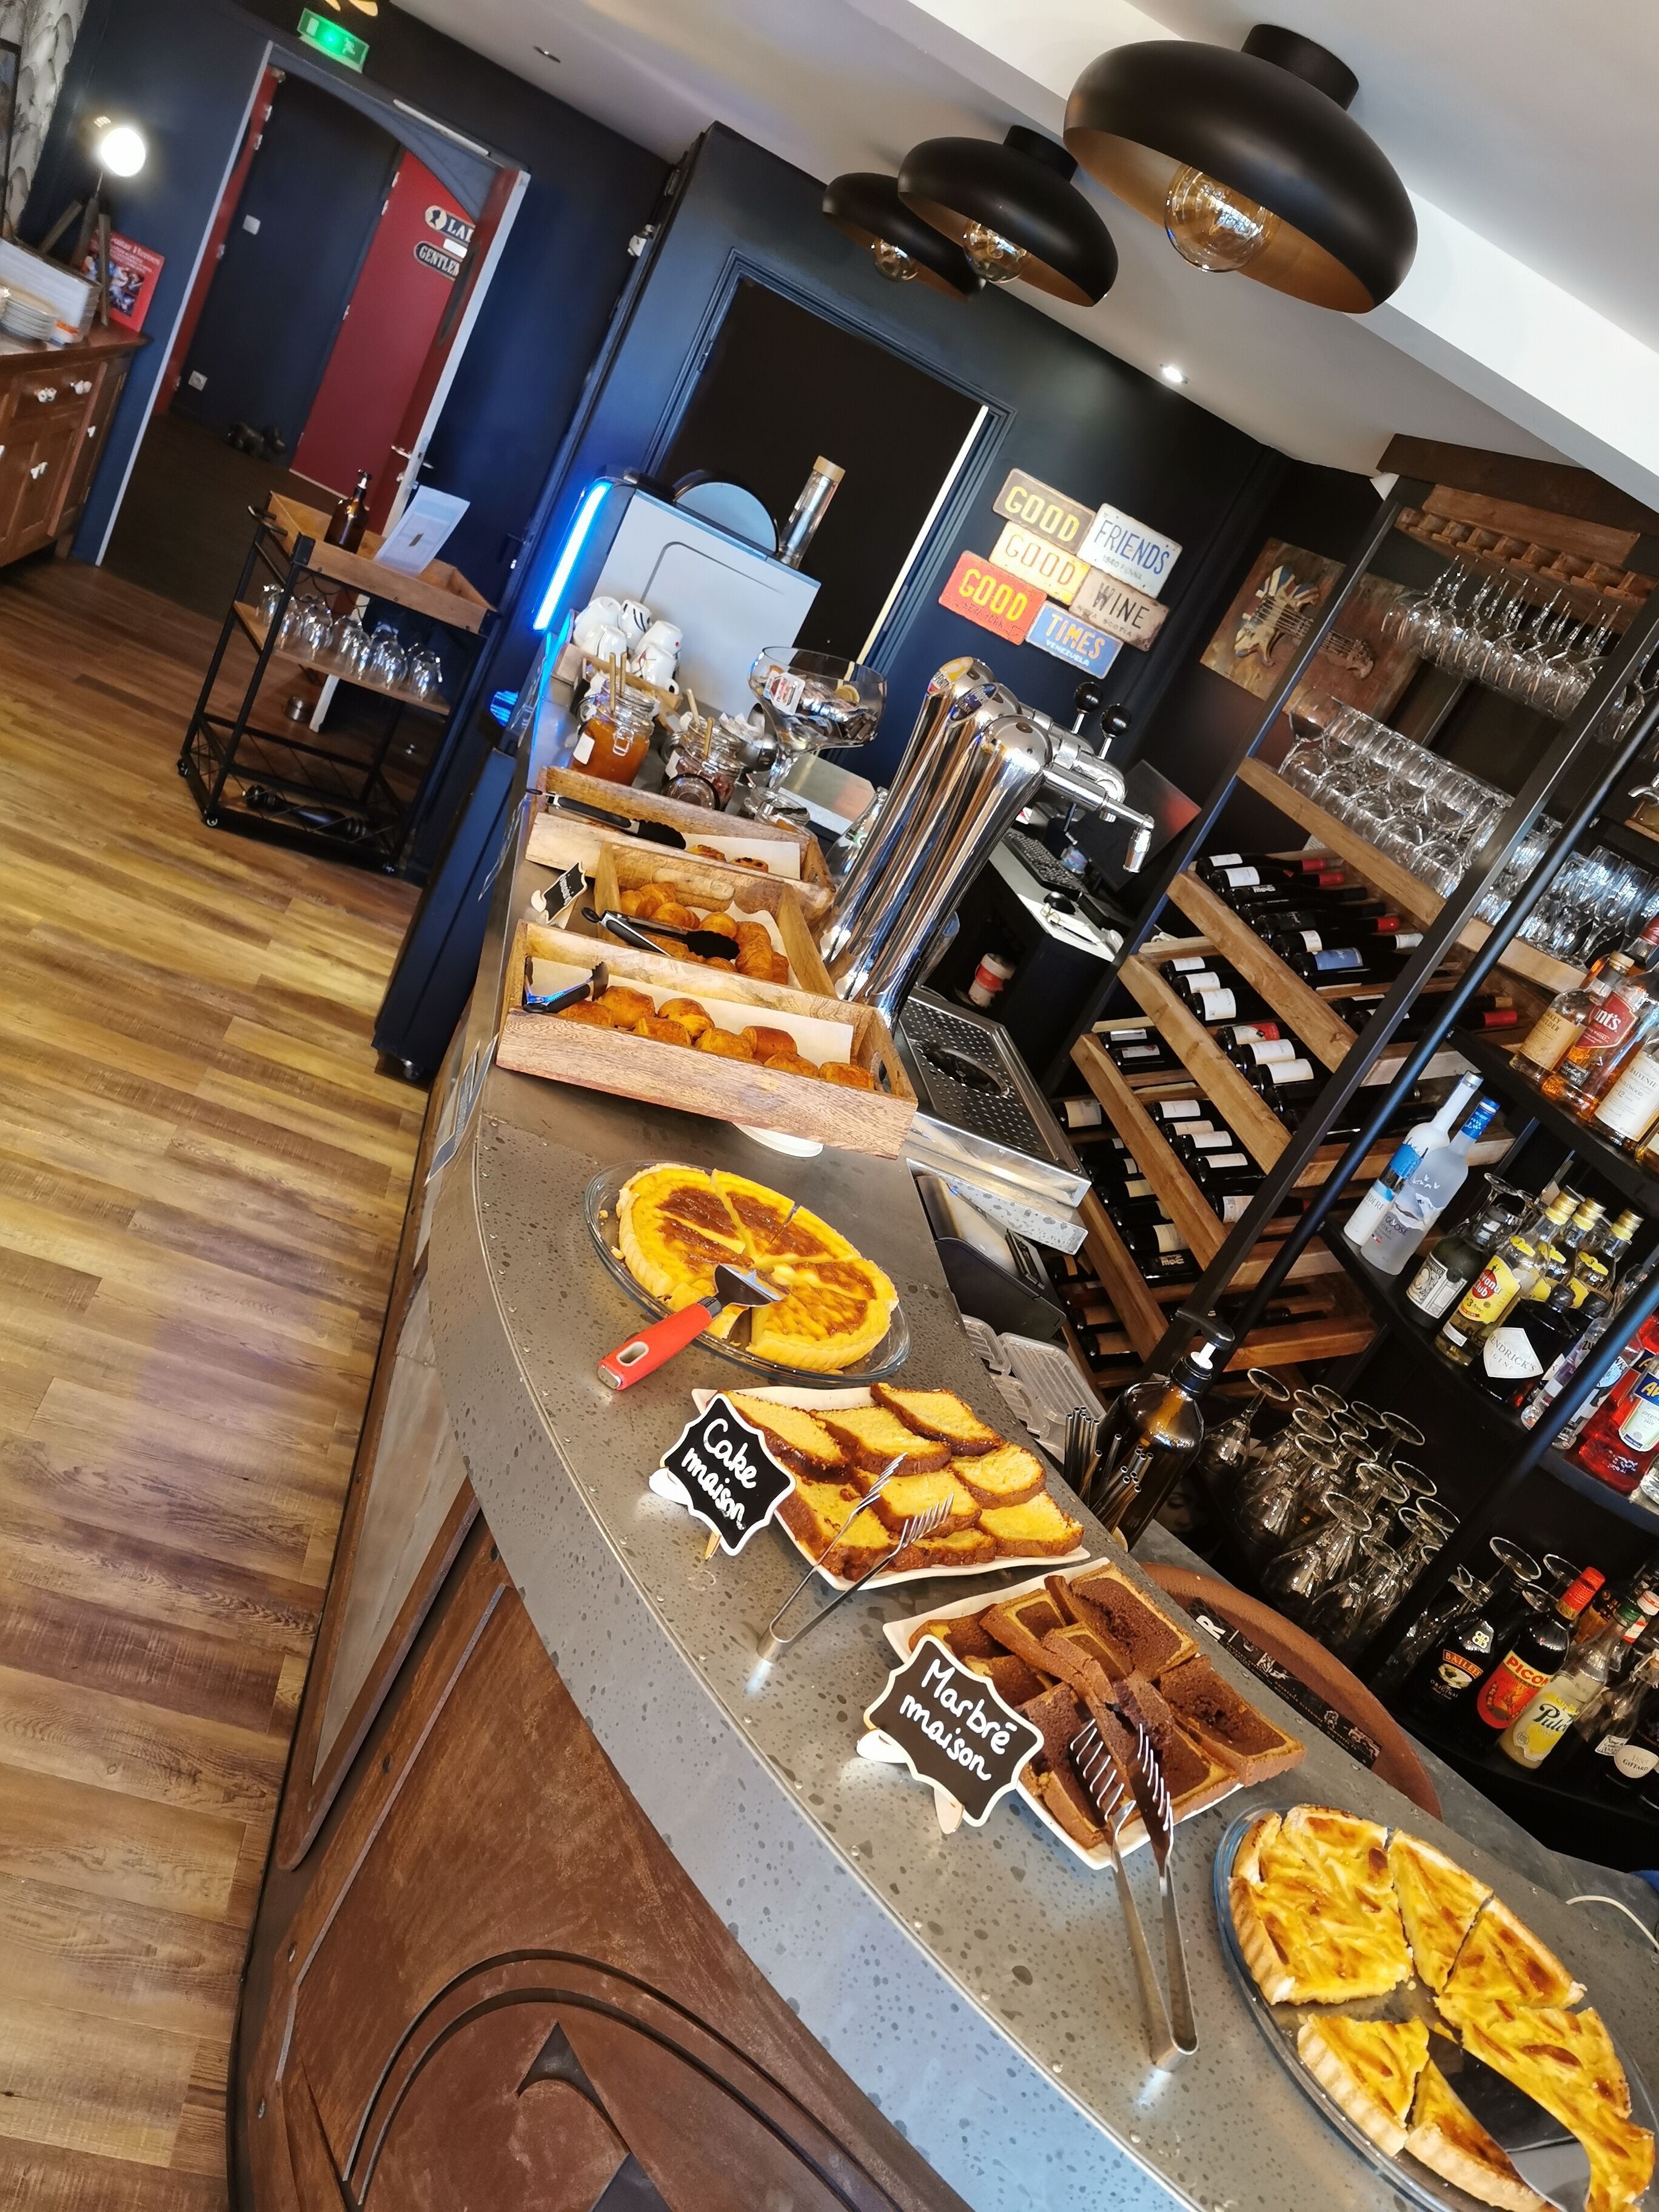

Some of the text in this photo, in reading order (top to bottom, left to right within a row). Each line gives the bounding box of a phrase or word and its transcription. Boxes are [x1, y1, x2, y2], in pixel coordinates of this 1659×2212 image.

[1004, 485, 1080, 542] GOOD
[1005, 534, 1075, 586] GOOD
[1094, 519, 1170, 575] FRIENDS
[959, 568, 1028, 622] GOOD
[1093, 581, 1150, 630] WINE
[1045, 614, 1105, 659] TIMES
[1046, 640, 1090, 667] VENEZUELA
[1103, 618, 1133, 638] SCOTIA
[1386, 1216, 1410, 1236] GOOSE
[1489, 1334, 1537, 1373] HENDRICK'S
[702, 1418, 757, 1489] Cake
[681, 1447, 746, 1530] maison
[1444, 1651, 1483, 1678] BAILEYS
[921, 1658, 1017, 1755] Marbré
[899, 1694, 992, 1781] maison
